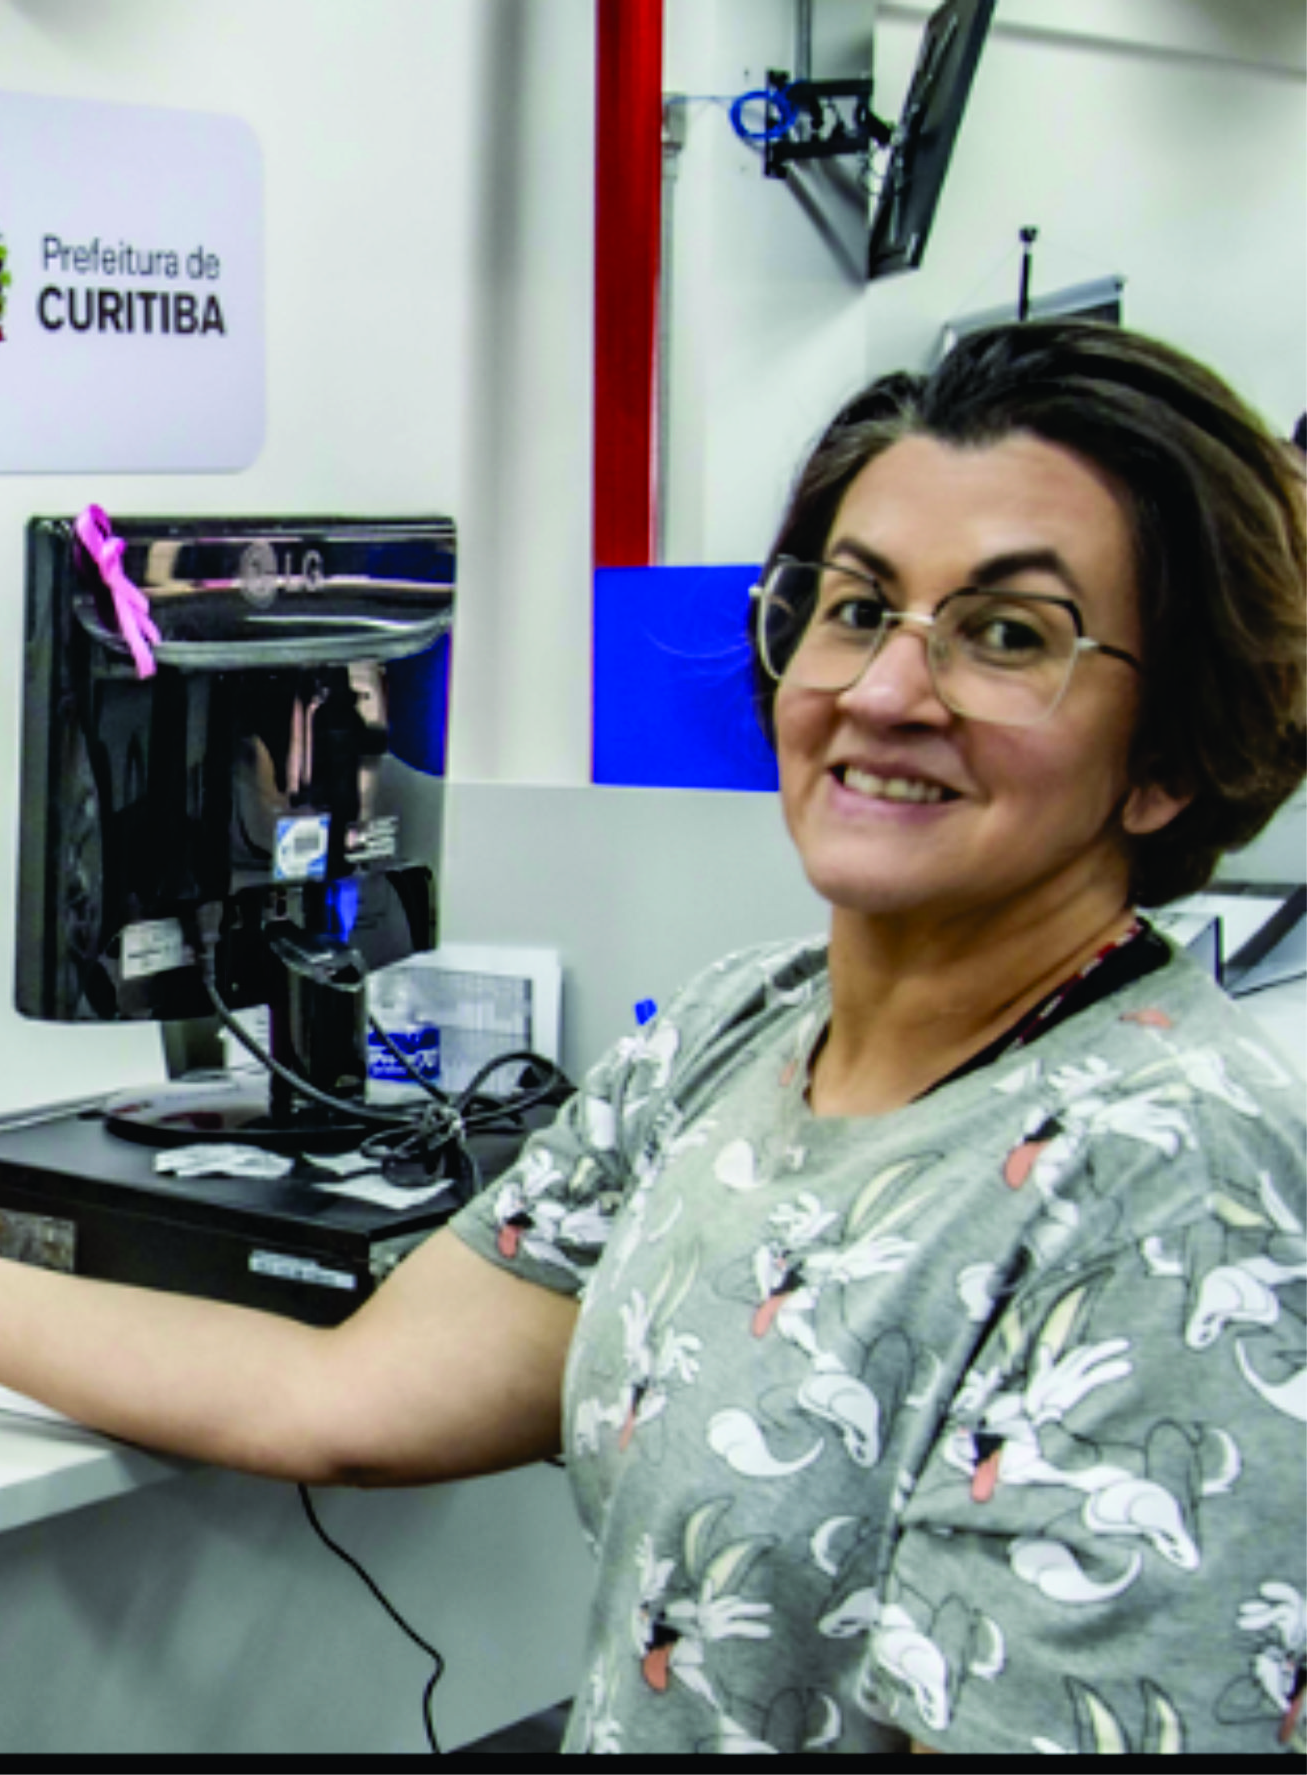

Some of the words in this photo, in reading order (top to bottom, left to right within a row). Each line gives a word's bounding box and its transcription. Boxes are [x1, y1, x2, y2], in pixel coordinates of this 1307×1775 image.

[42, 234, 180, 279] Prefeitura
[186, 246, 220, 281] de
[37, 285, 225, 335] CURITIBA
[283, 549, 324, 593] LG
